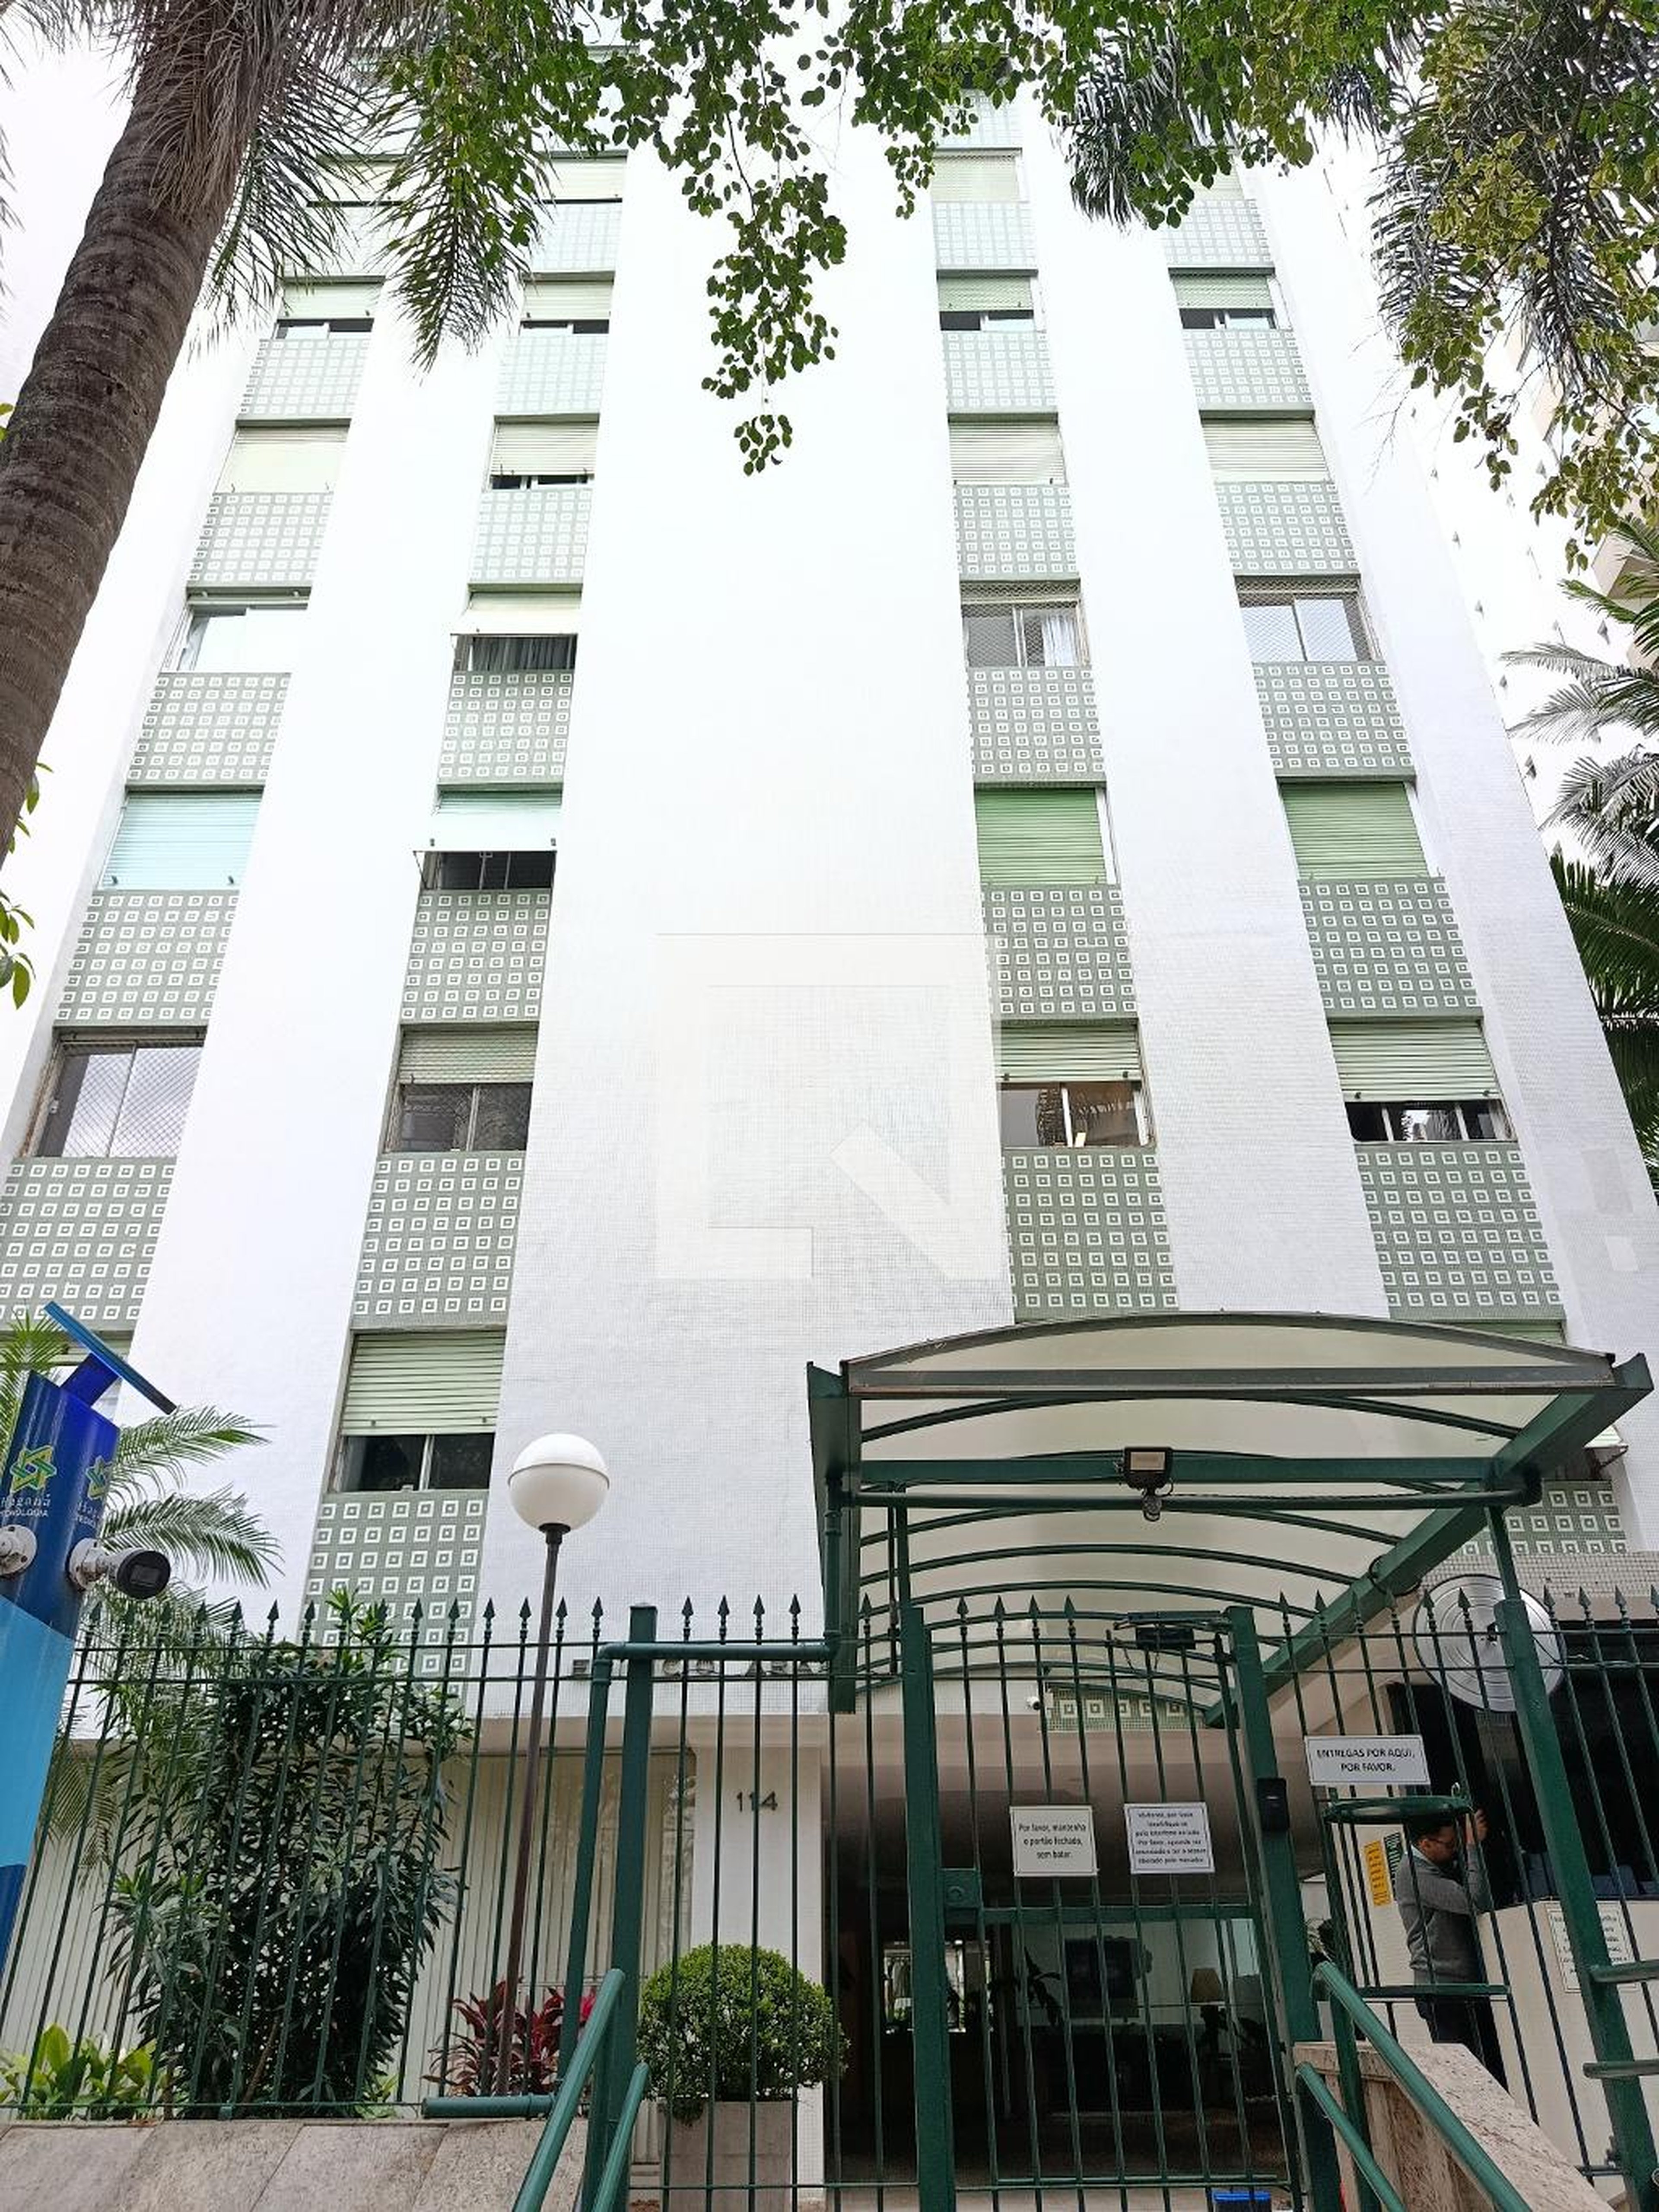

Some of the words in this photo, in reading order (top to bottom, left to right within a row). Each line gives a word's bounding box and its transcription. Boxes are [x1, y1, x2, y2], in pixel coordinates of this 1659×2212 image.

[1316, 1749, 1365, 1758] ENTREGAS
[1367, 1749, 1386, 1757] POR
[1341, 1763, 1360, 1771] POR
[737, 1791, 778, 1812] 114
